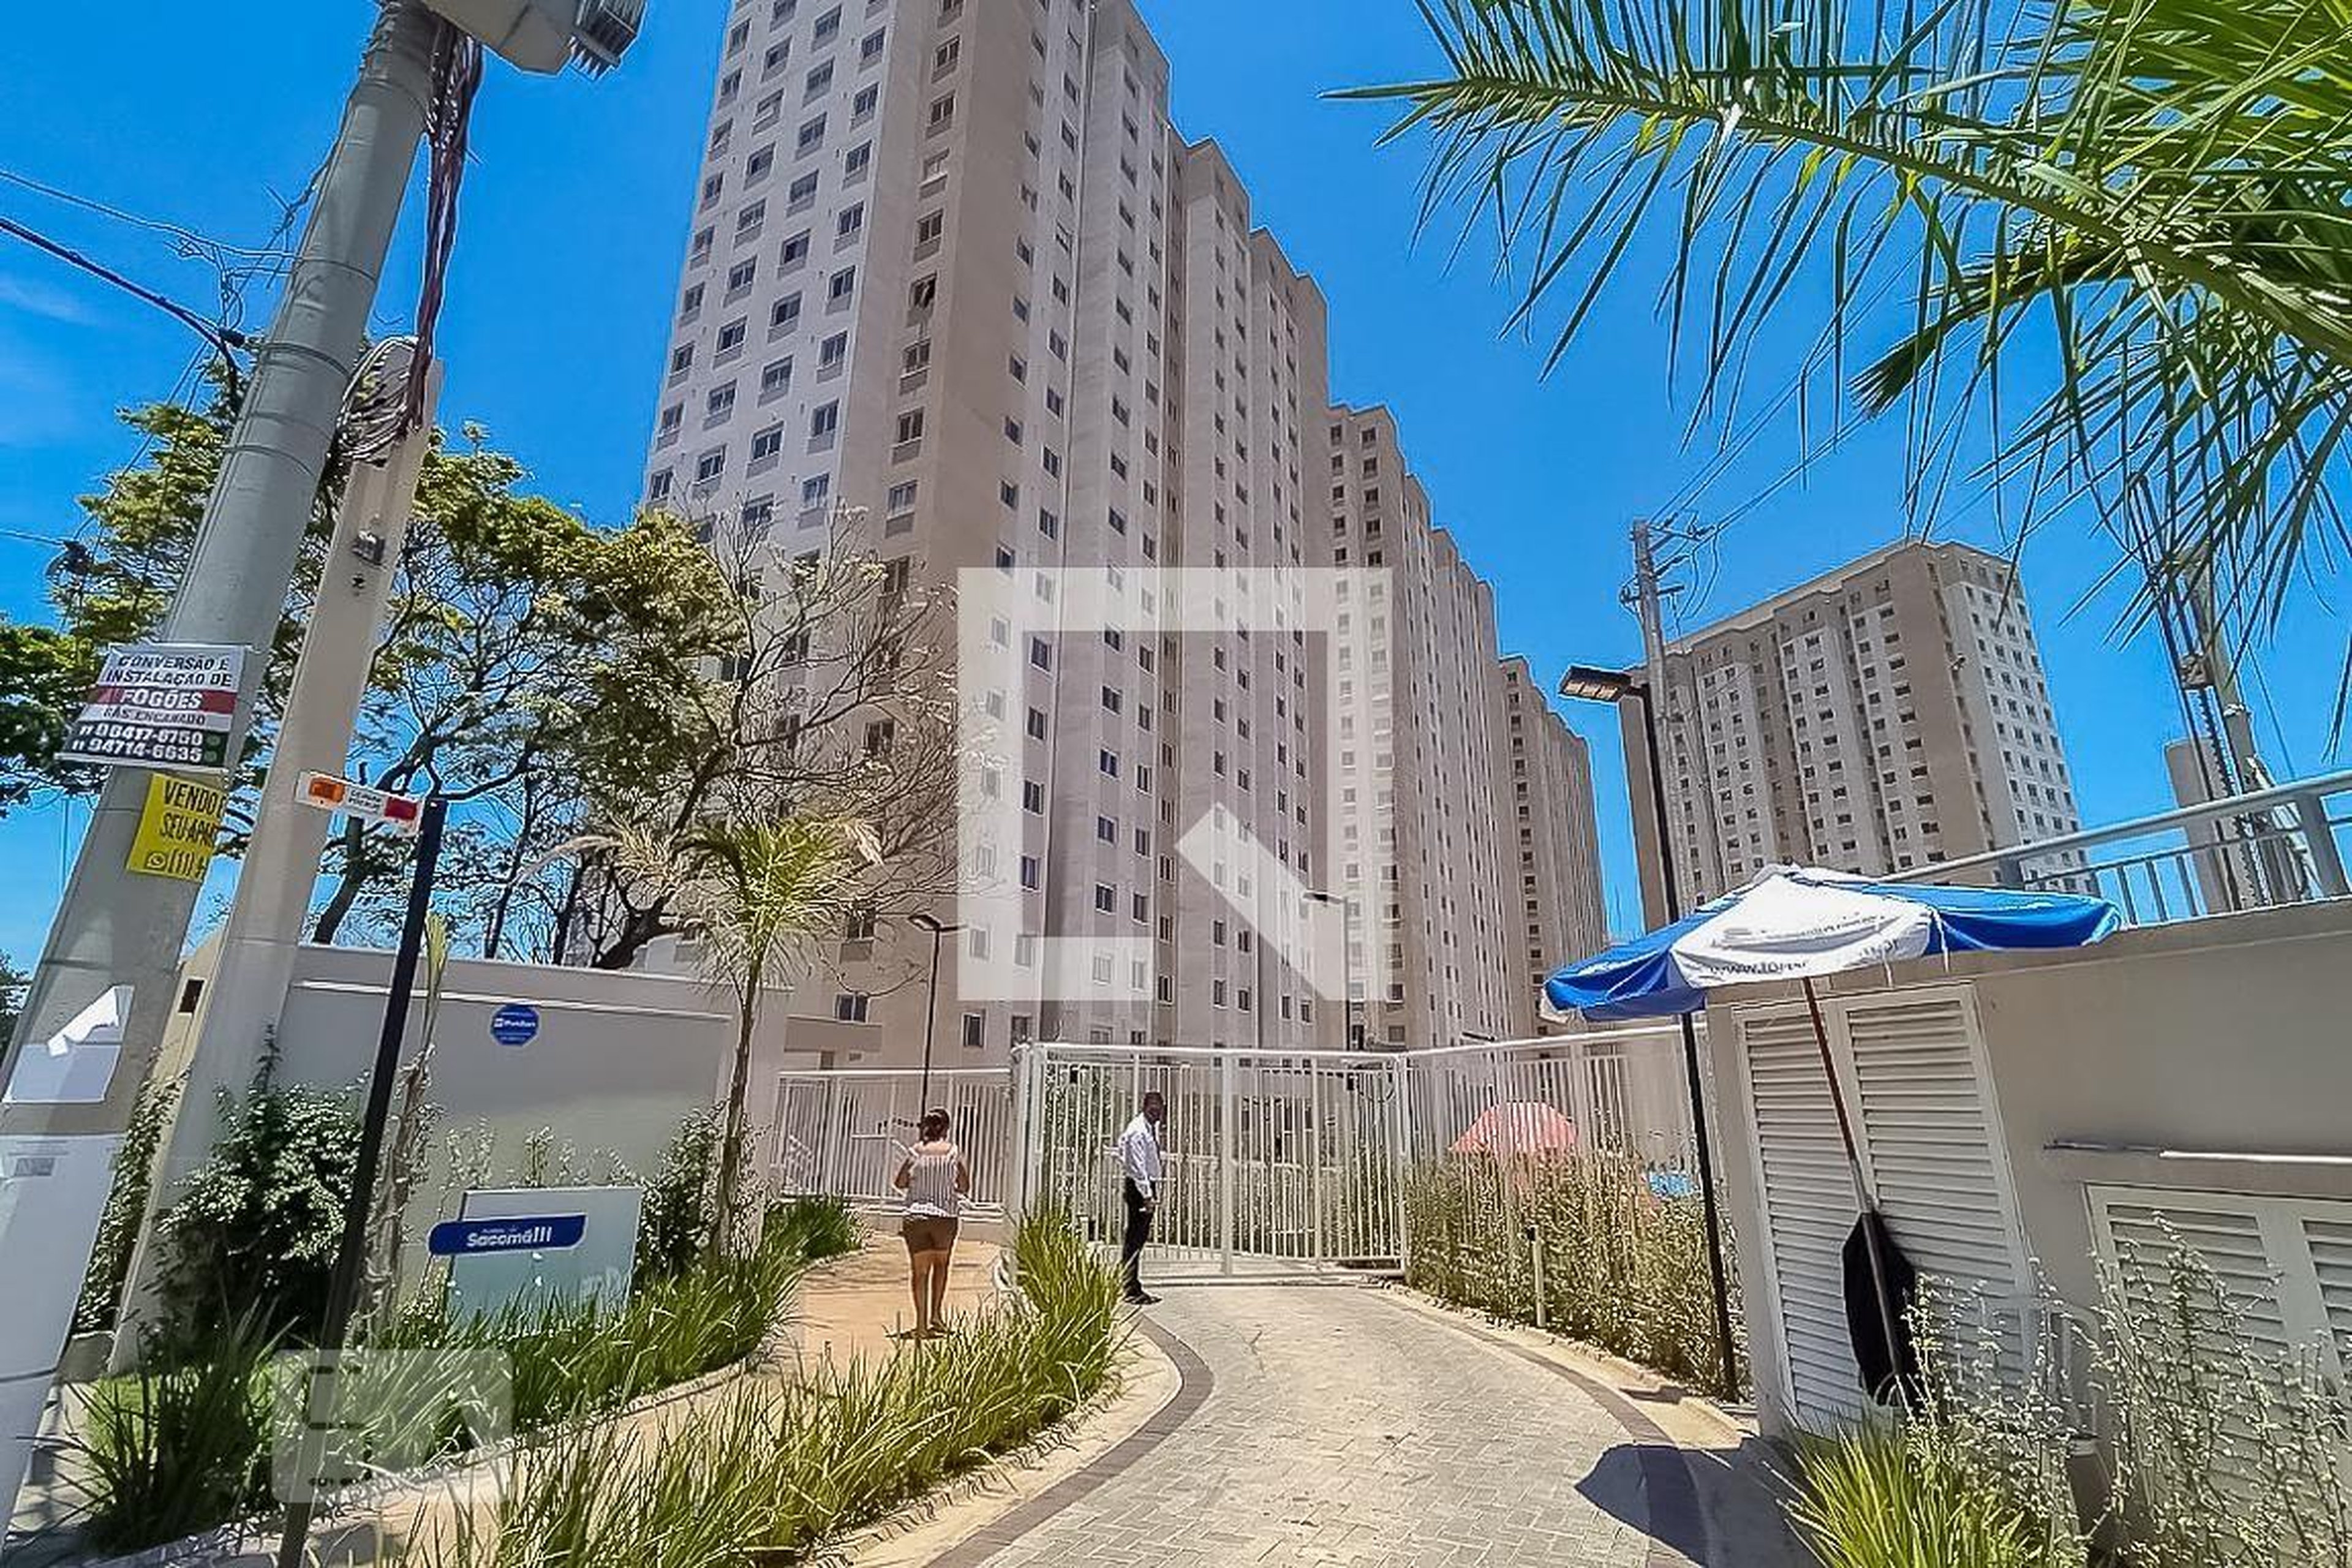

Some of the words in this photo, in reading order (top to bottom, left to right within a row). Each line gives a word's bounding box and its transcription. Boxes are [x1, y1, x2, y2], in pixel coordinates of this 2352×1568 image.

[118, 655, 214, 671] CONVERSÃO
[209, 673, 232, 686] DE
[164, 780, 217, 815] VENDO
